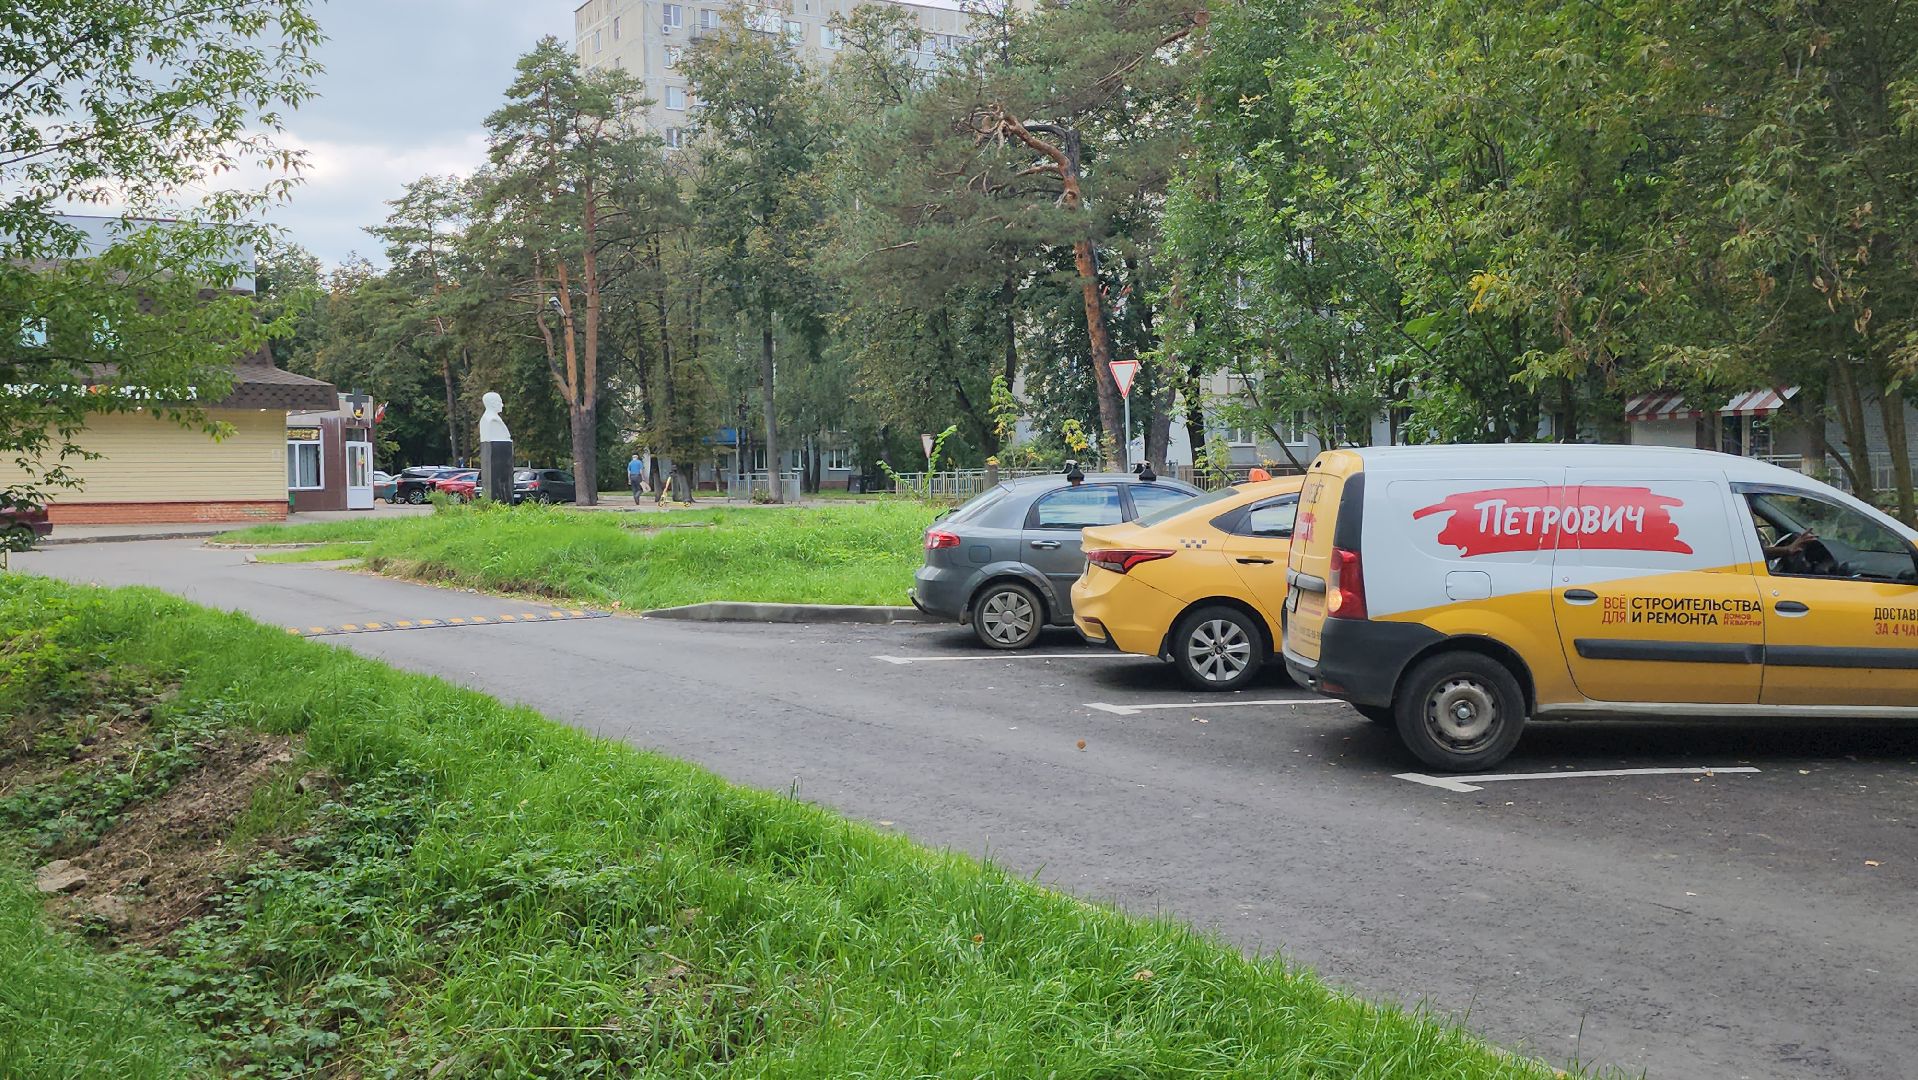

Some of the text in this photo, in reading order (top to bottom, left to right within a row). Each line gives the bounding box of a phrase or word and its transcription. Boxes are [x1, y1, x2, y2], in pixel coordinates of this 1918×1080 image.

[1603, 594, 1626, 610] ВСЁ
[1631, 597, 1762, 612] СТРОИТЕЛЬСТВА
[1602, 611, 1626, 625] ДЛЯ
[1631, 611, 1718, 625] И РЕМОНТА
[1874, 608, 1918, 620] ДОСТАВ
[1875, 623, 1918, 636] ЗА 4 ЧА
